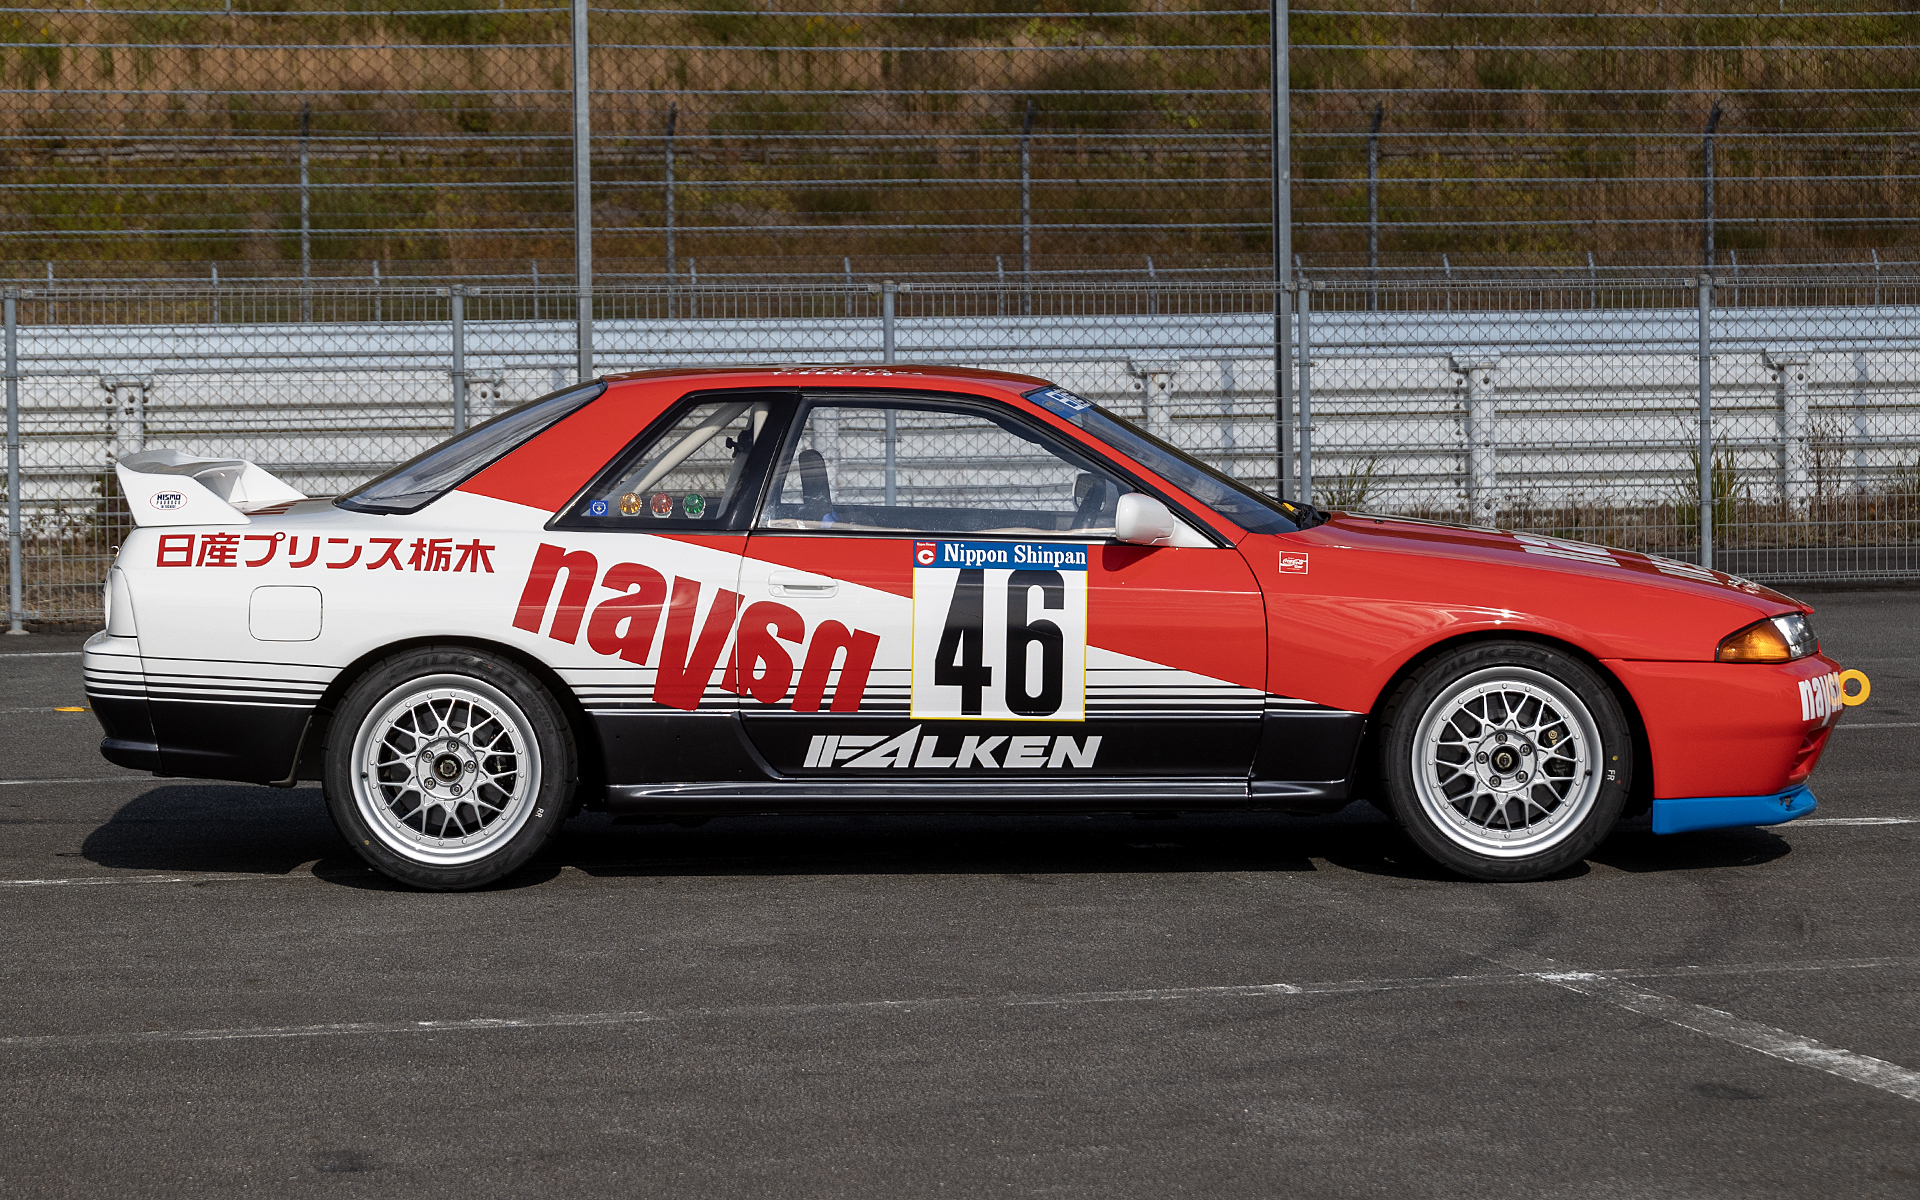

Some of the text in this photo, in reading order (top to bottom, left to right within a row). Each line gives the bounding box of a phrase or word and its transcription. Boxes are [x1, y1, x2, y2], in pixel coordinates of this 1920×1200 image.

[156, 531, 496, 574] 日産プリンス栃木
[944, 543, 1087, 568] Nippon Shinpan
[934, 568, 1066, 717] 46
[802, 723, 1103, 769] FALKEN
[1606, 769, 1616, 782] FR
[535, 807, 545, 819] RR
